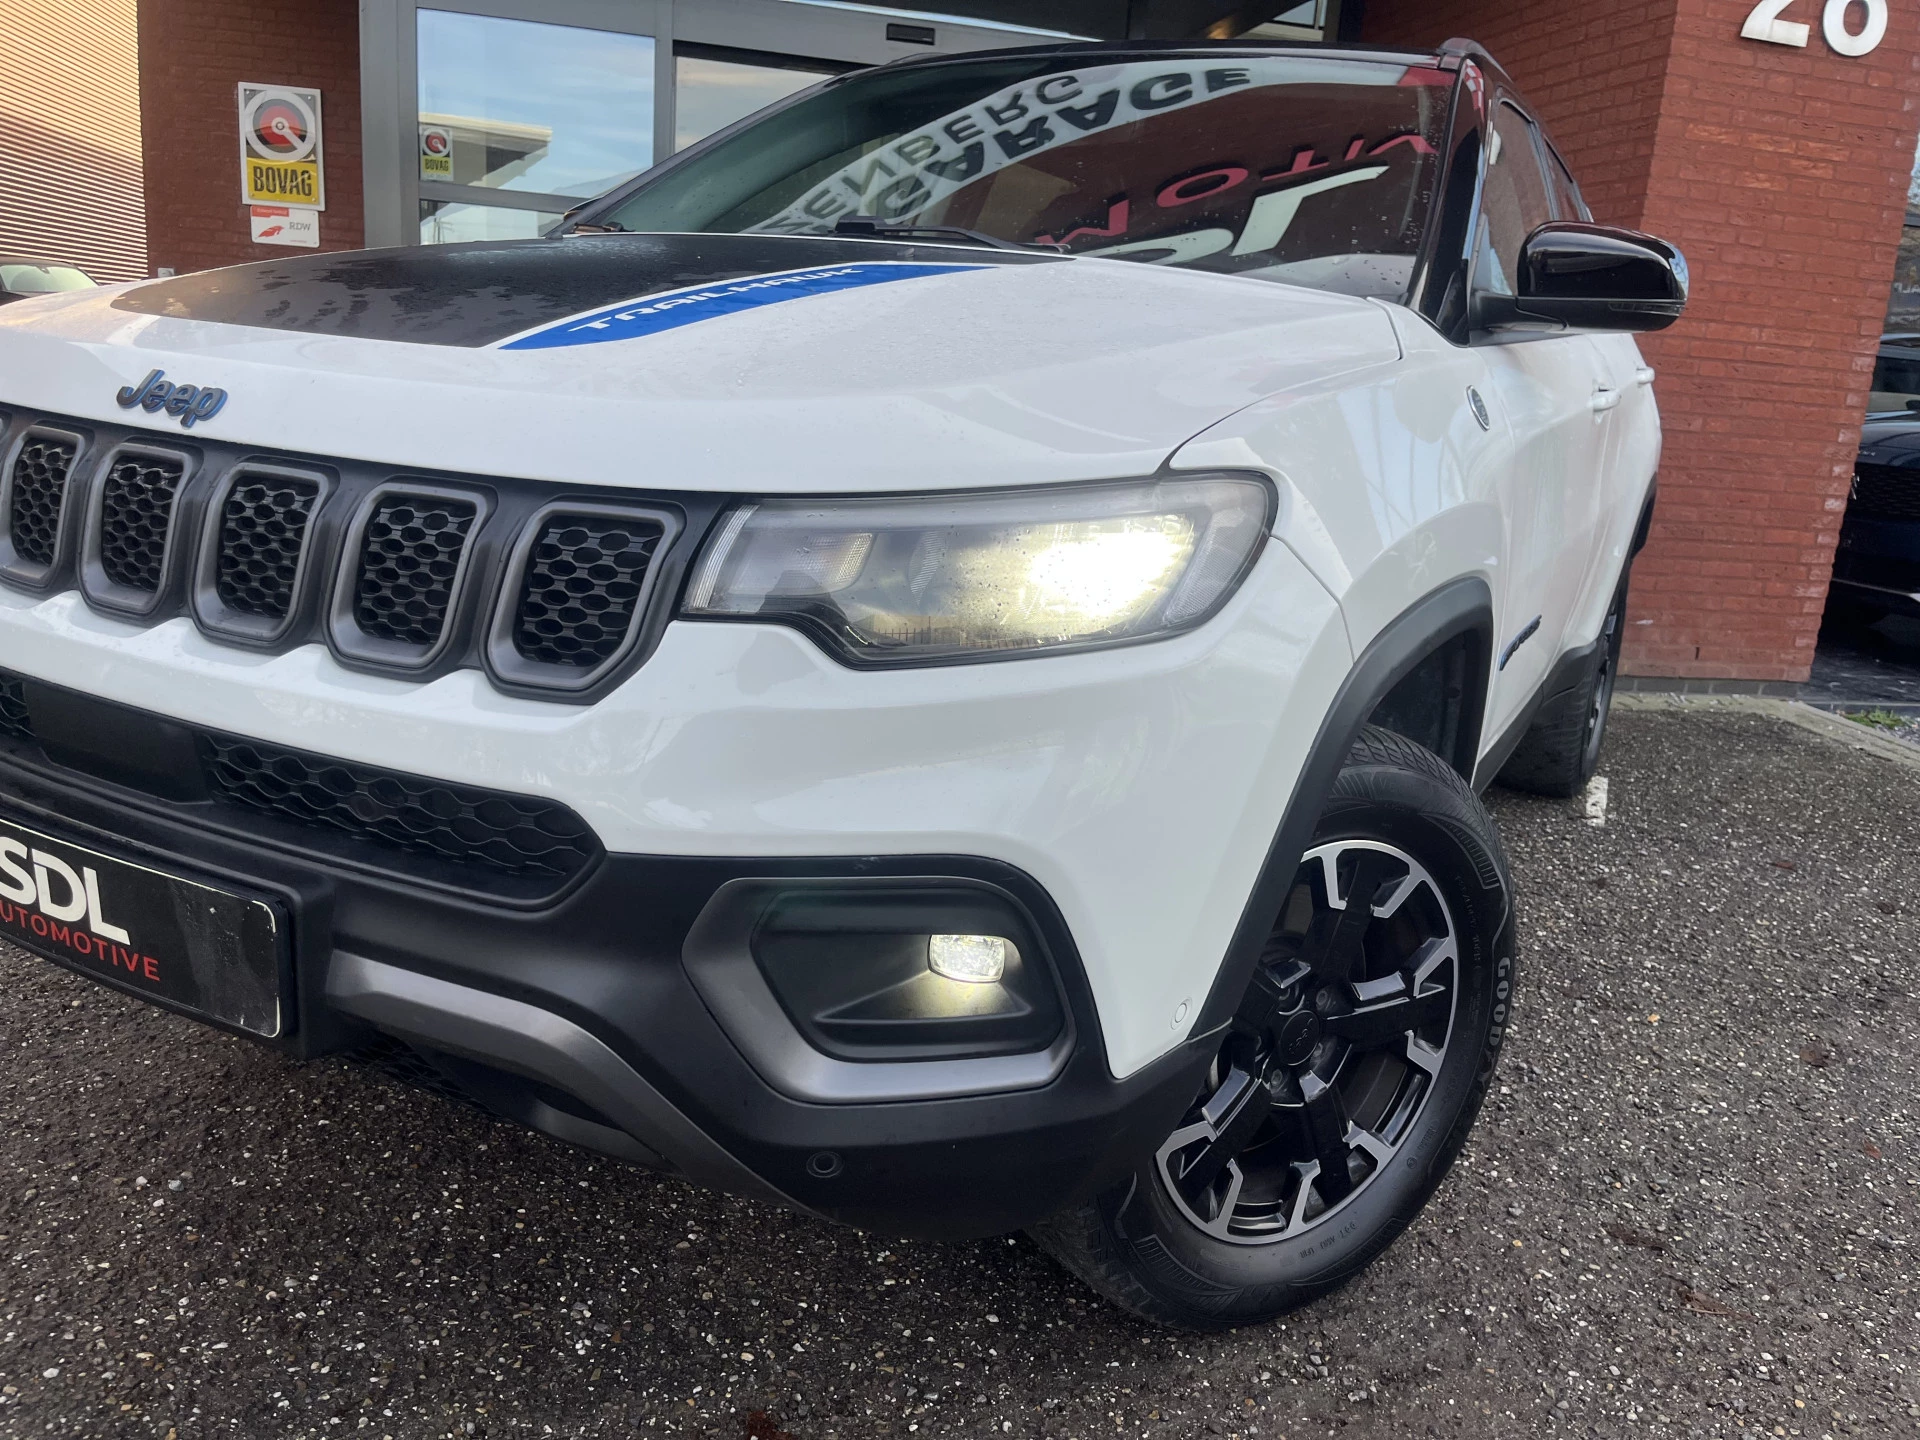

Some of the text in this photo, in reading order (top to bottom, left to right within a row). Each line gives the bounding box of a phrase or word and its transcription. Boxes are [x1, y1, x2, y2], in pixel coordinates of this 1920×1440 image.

[253, 165, 312, 197] BOVAG
[425, 158, 449, 171] BOVAG
[289, 221, 312, 231] RDW
[567, 268, 864, 332] TRAILHAWK
[115, 368, 229, 429] Jeep
[0, 836, 131, 946] SDL
